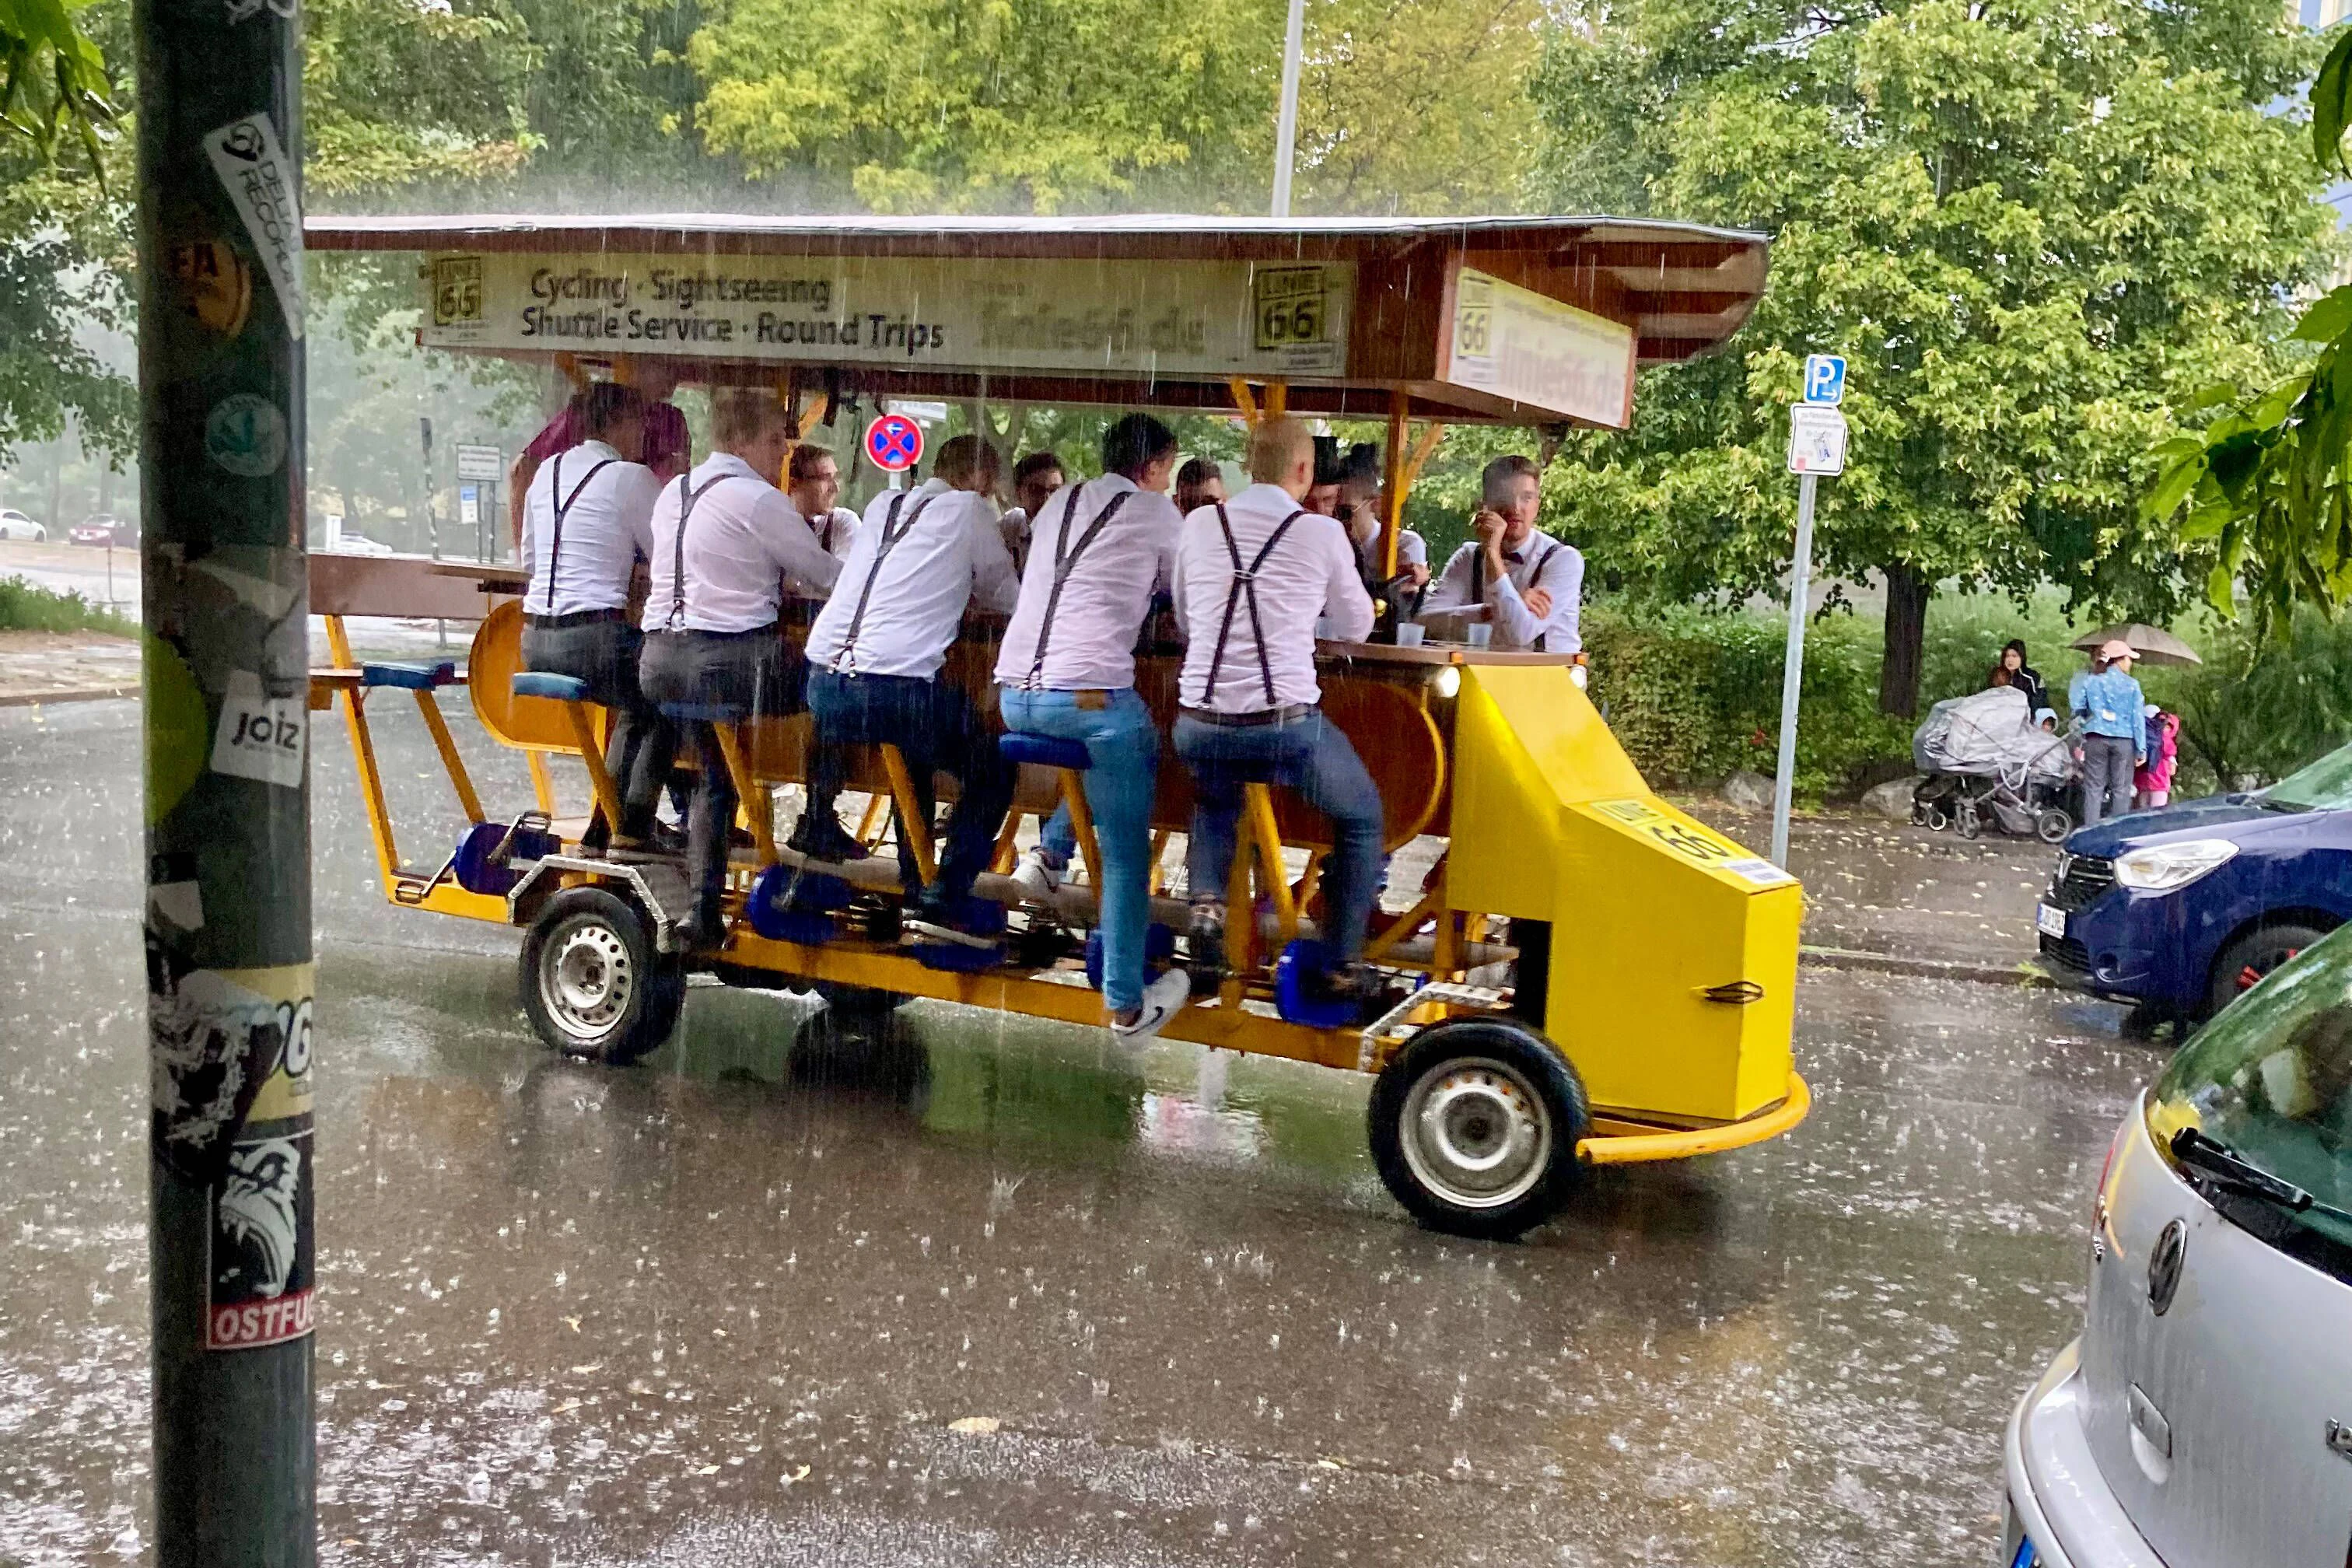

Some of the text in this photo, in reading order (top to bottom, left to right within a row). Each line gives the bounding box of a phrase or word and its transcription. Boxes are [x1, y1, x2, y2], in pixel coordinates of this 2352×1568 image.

[531, 268, 831, 312] Cycling Sightseeing
[521, 306, 620, 339] Shuttle
[628, 310, 733, 342] Service
[757, 311, 859, 346] Round
[868, 313, 944, 356] Trips
[1263, 299, 1321, 340] 66
[1459, 311, 1486, 351] 66
[1810, 359, 1836, 397] P
